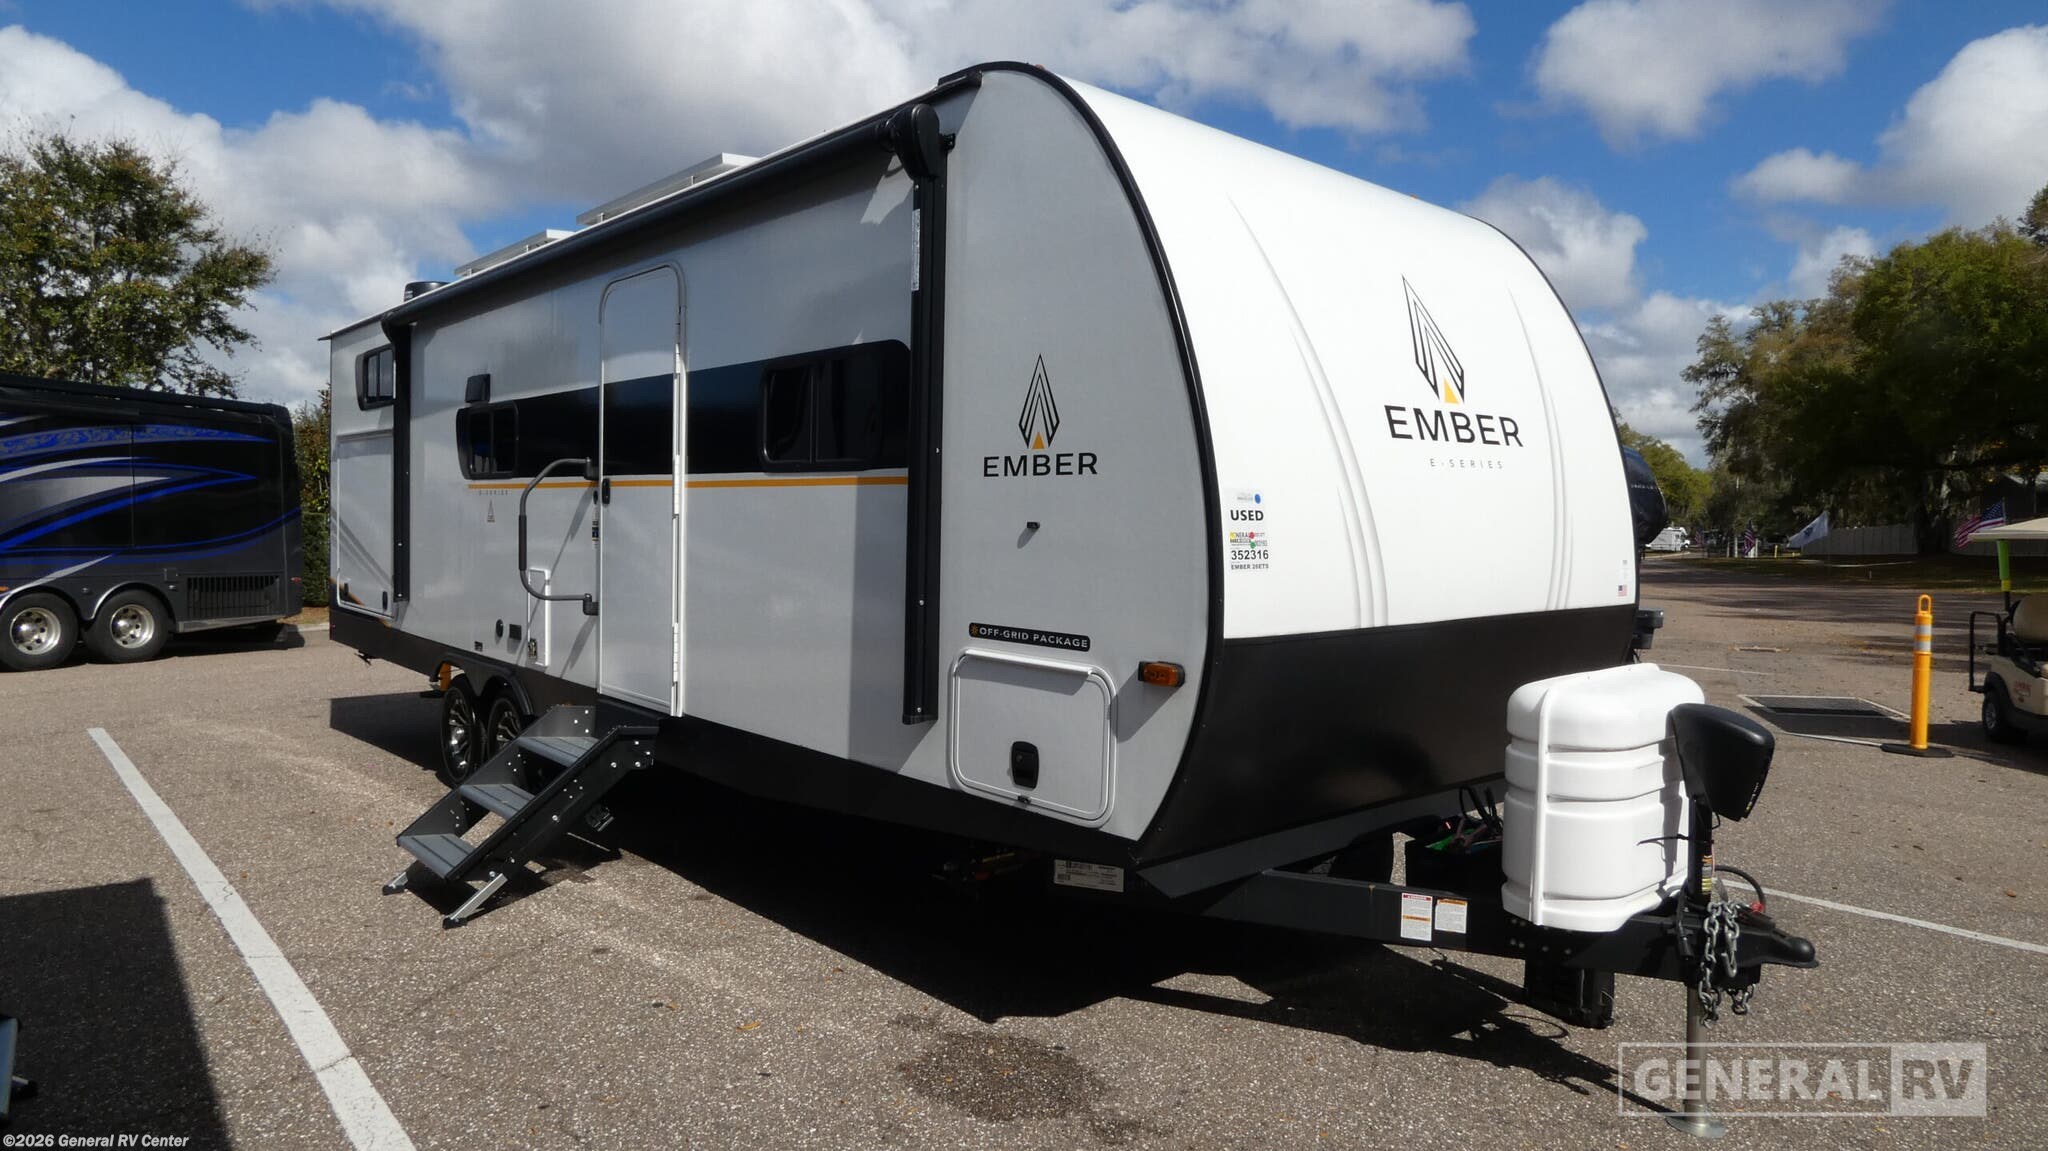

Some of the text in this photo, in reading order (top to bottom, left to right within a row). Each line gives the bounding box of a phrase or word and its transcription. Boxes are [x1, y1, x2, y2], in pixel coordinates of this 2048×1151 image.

[1384, 404, 1523, 447] EMBER
[983, 452, 1098, 477] EMBER
[1230, 509, 1264, 521] USED
[1231, 549, 1269, 560] 352316
[979, 626, 1088, 648] OFF-GRID PACKAGE
